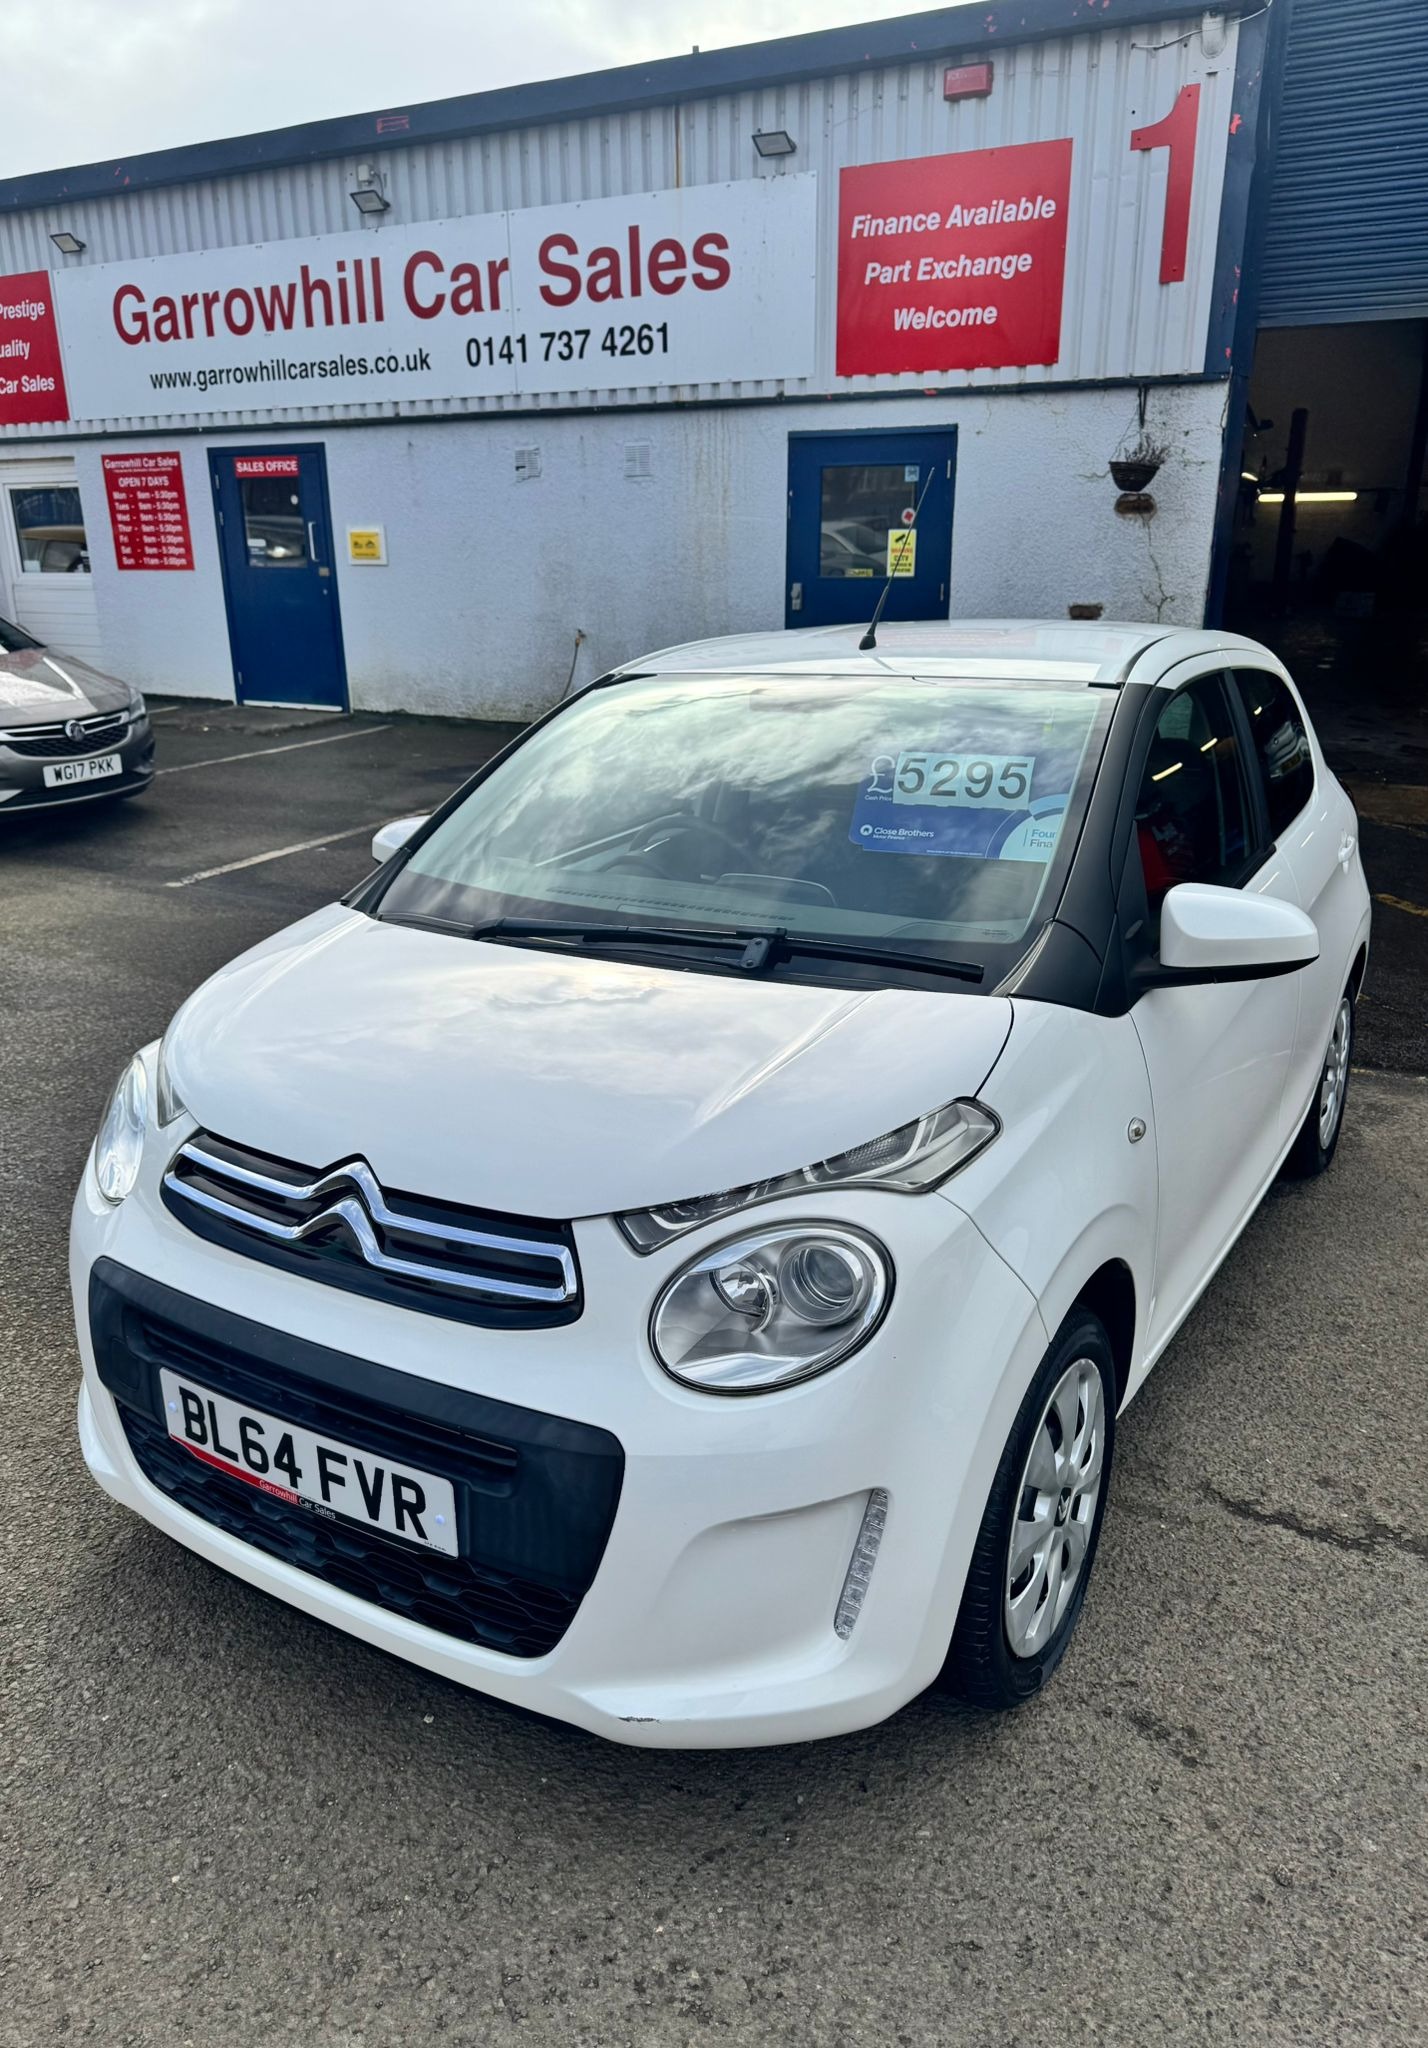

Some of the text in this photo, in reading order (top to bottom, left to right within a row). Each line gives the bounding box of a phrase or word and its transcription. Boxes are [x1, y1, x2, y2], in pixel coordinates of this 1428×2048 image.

[1129, 83, 1201, 284] 1
[851, 195, 1057, 239] Finance Available
[864, 251, 1033, 285] Part Exchange
[112, 224, 731, 345] Garrowhill Car Sales
[893, 305, 998, 331] Welcome
[149, 321, 669, 392] www.garrowhillcarsales.co.uk 0141 737 4261
[21, 374, 55, 393] Sales
[104, 456, 178, 469] Garrowhill Car Sales
[236, 459, 298, 473] SALES OFFICE
[118, 477, 140, 487] OPEN
[147, 475, 170, 486] DAYS
[54, 758, 114, 782] WG17 PKK
[873, 827, 935, 838] Close Brothers
[178, 1385, 429, 1541] BL64 FVR
[259, 1479, 337, 1521] Garrowhill Car Sales
